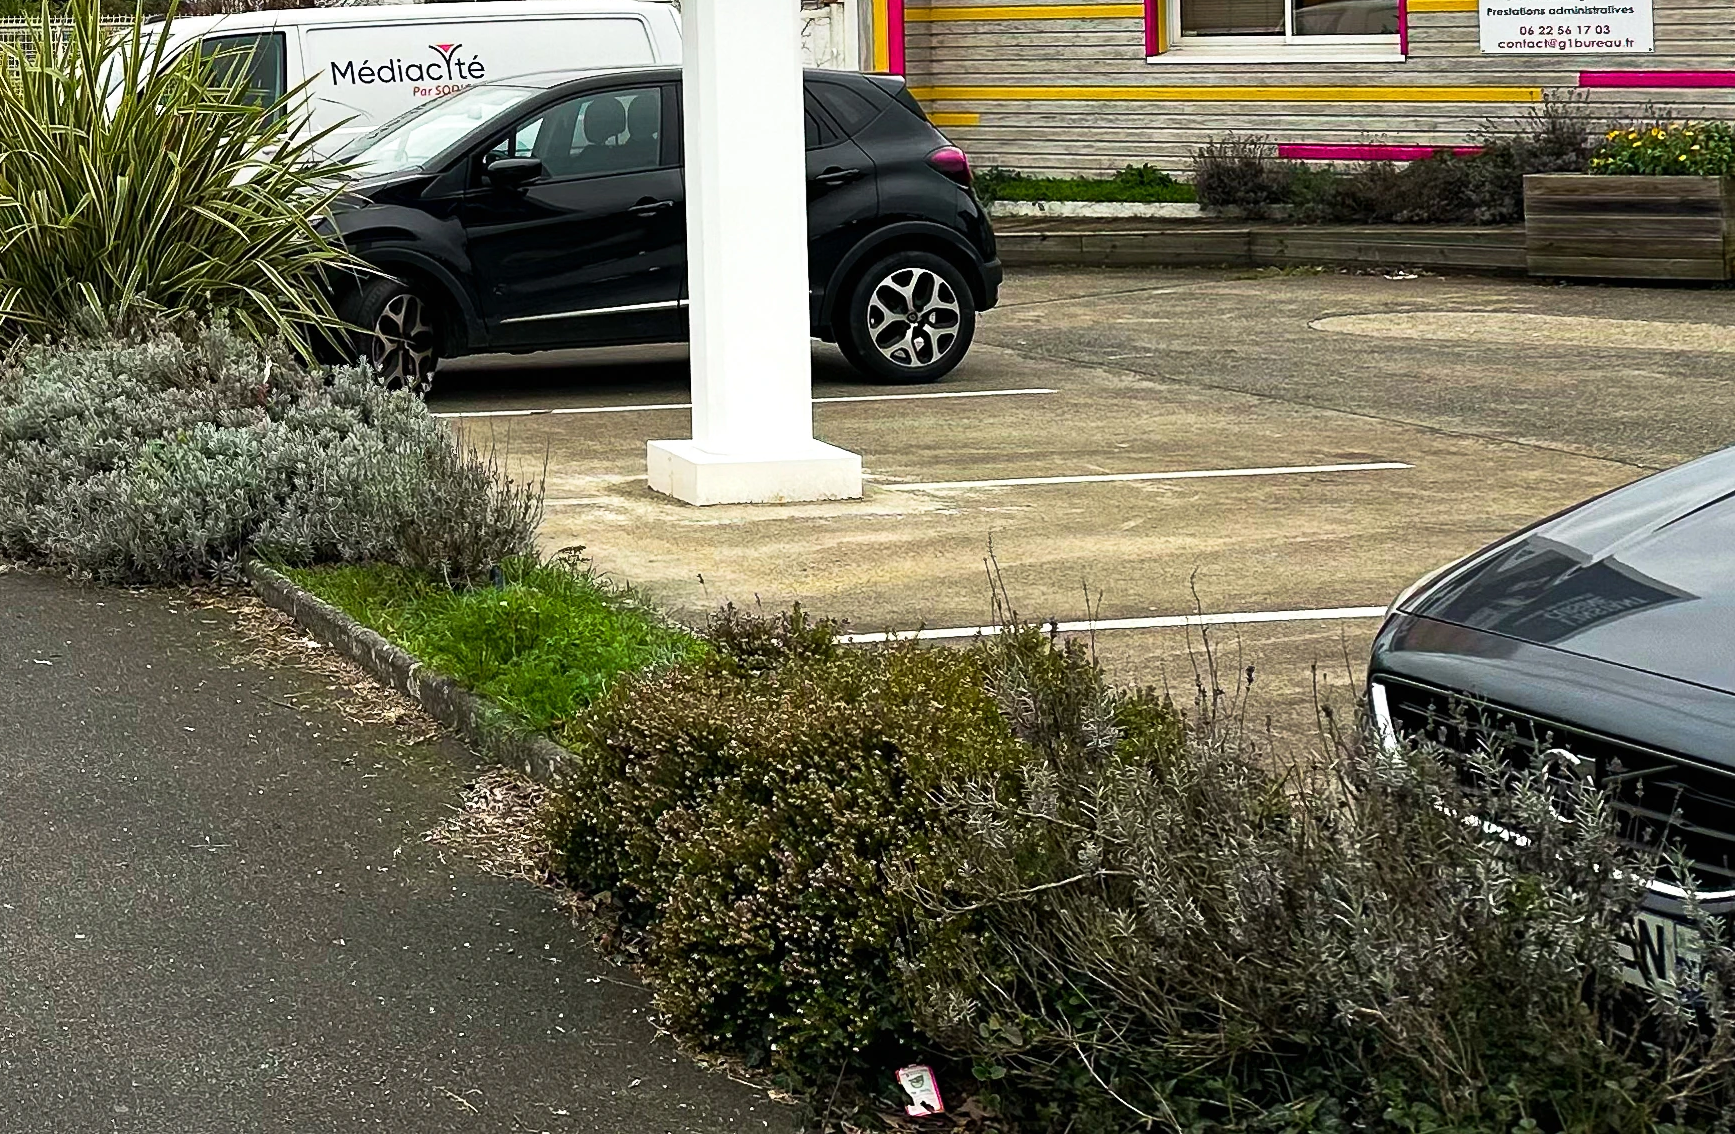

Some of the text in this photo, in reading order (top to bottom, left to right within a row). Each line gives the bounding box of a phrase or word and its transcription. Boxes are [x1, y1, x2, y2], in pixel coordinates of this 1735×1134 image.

[1487, 5, 1635, 16] Prestations administratives
[1519, 25, 1611, 36] 06 22 56 17 03
[413, 86, 433, 96] Par
